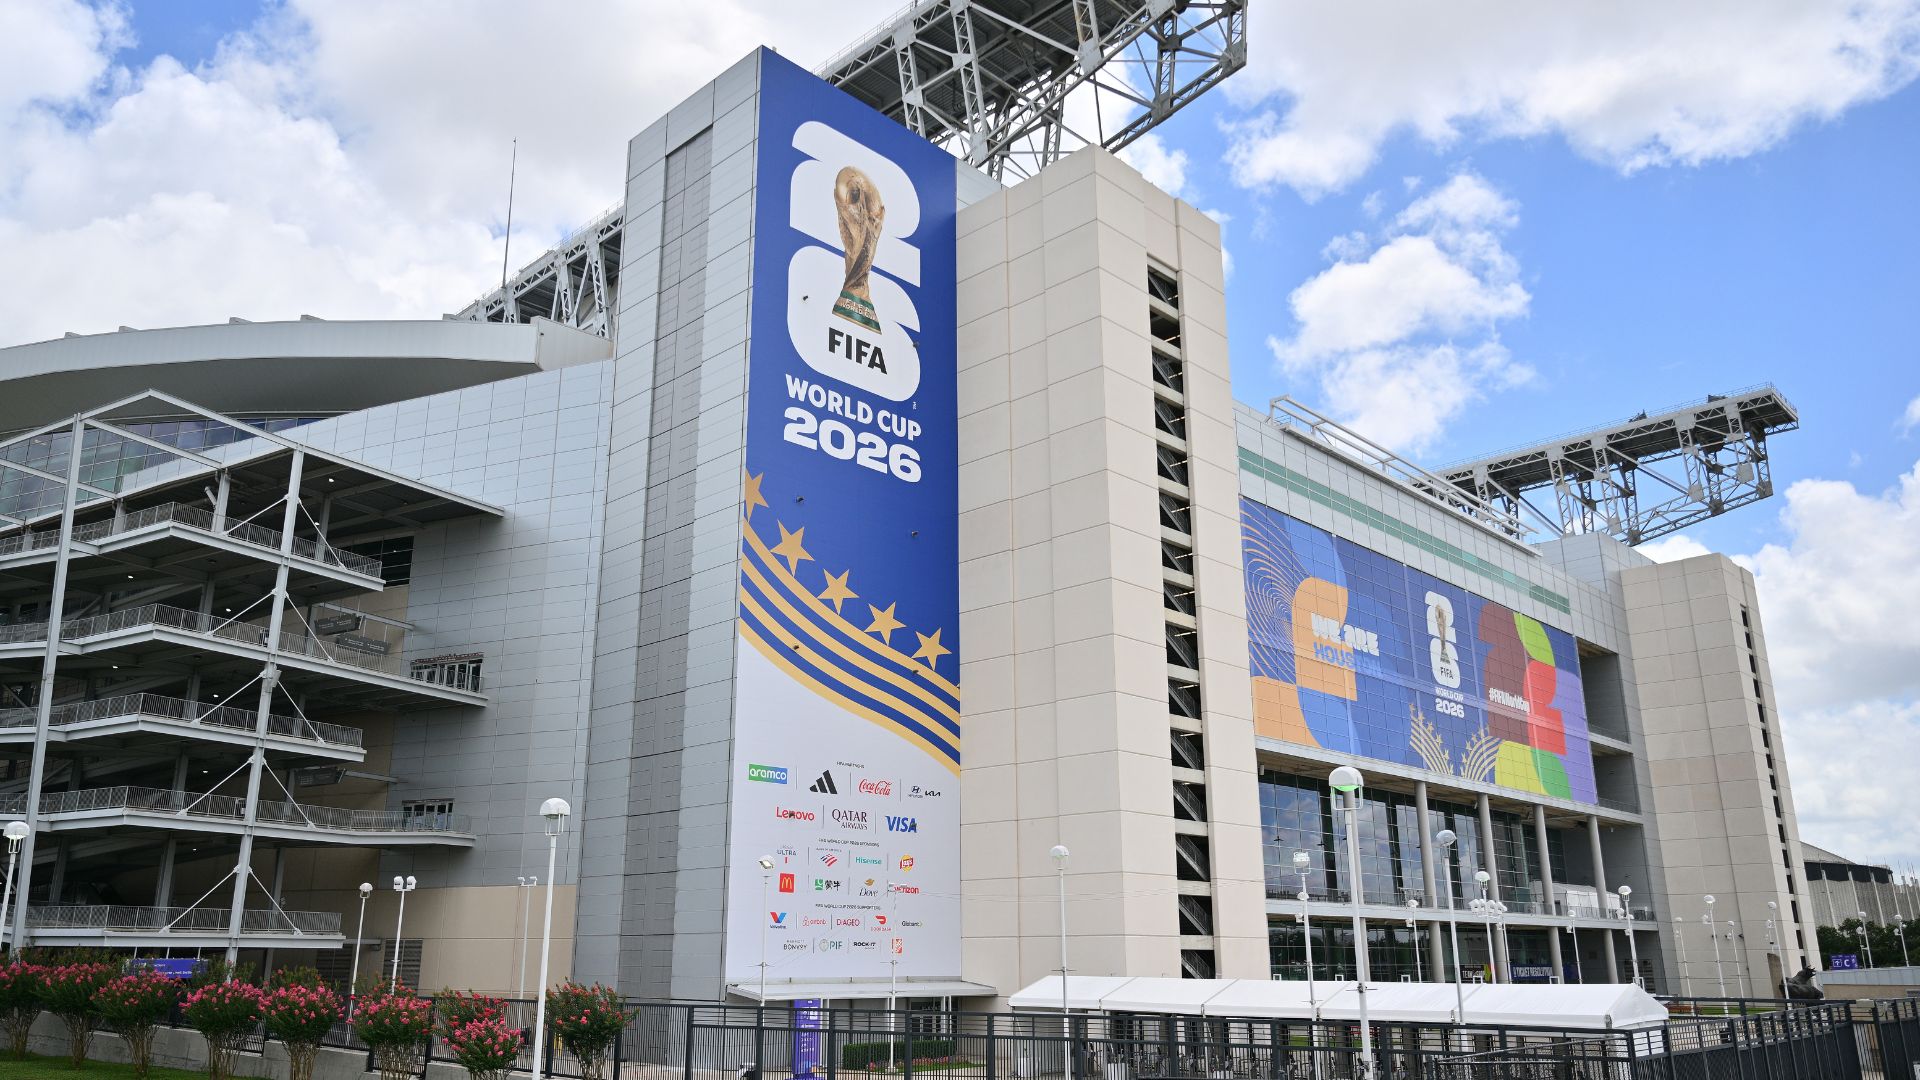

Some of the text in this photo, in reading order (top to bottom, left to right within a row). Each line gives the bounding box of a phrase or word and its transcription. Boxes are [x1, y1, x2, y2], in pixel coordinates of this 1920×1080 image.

[828, 327, 888, 375] FIFA
[785, 373, 922, 441] WORLD CUP
[783, 406, 922, 483] 2026
[1440, 667, 1454, 680] FIFA
[1435, 697, 1465, 718] 2026
[749, 767, 787, 781] aramco
[776, 806, 815, 821] Lenovo
[832, 808, 867, 823] QATAR
[841, 821, 868, 831] AIRWAYS
[885, 815, 918, 833] VISA
[776, 849, 797, 857] ULTRA
[855, 856, 882, 865] Hisense
[859, 886, 879, 897] Dove
[809, 918, 827, 926] airbnb
[836, 918, 861, 927] DIAGEO
[829, 940, 843, 950] PIF
